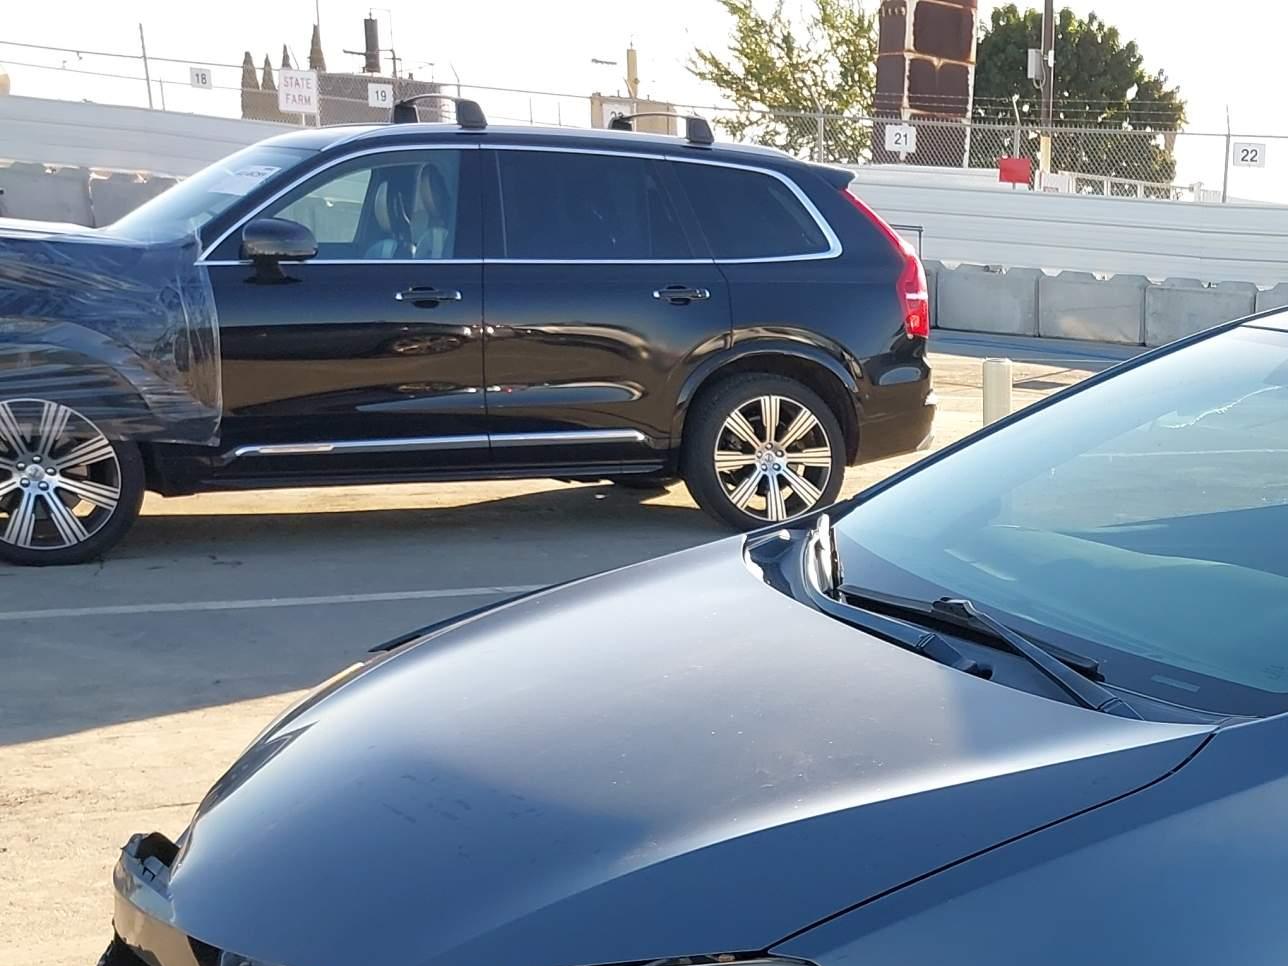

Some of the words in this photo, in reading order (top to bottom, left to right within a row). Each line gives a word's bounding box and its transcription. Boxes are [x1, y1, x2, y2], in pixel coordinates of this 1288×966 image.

[195, 73, 207, 85] 18
[283, 76, 312, 89] STATE
[286, 93, 311, 106] FARM
[375, 90, 387, 102] 19
[894, 132, 908, 146] 21
[1240, 149, 1258, 162] 22
